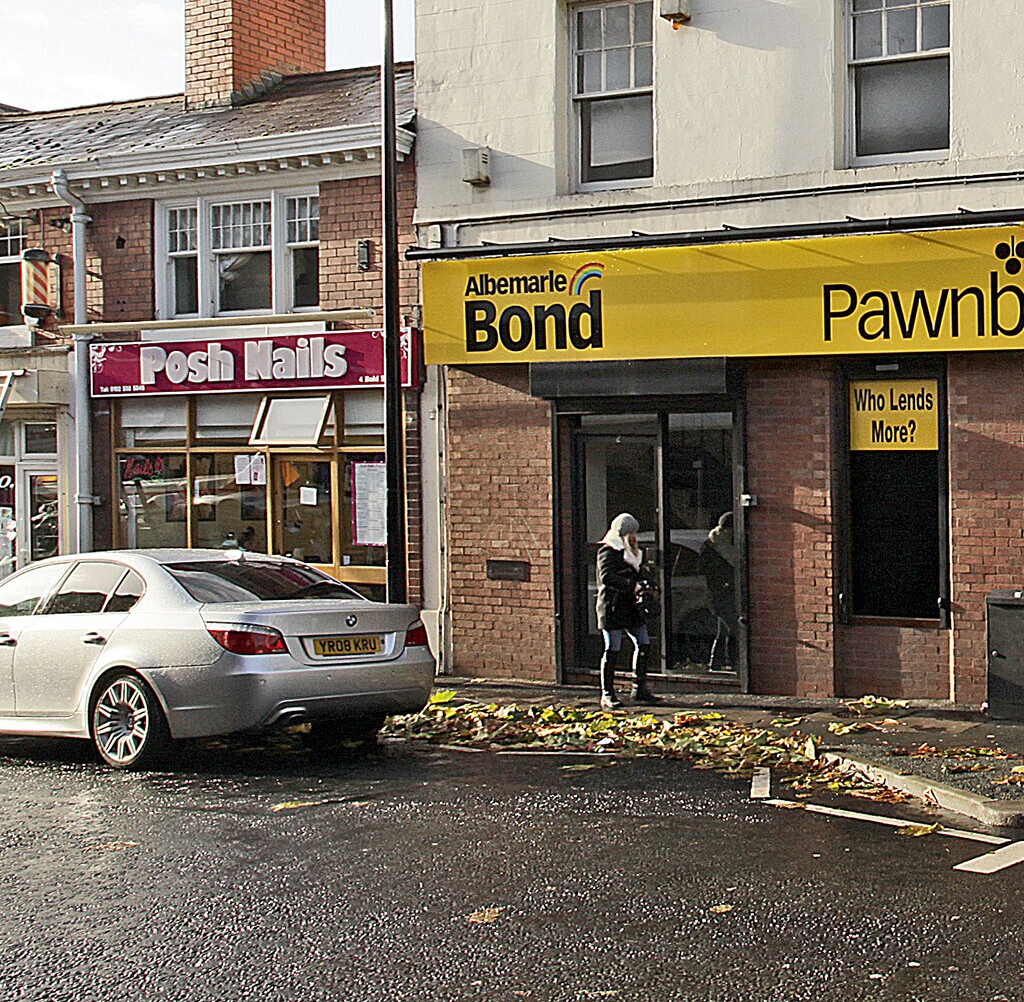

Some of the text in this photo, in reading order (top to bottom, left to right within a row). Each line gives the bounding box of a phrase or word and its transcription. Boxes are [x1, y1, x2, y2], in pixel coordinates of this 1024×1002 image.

[465, 270, 567, 296] Albemarle
[465, 290, 603, 352] Bond
[140, 337, 348, 384] Posh Nails
[854, 387, 933, 411] Who Lends
[872, 419, 916, 442] More?
[319, 639, 377, 652] YR08 KRU
